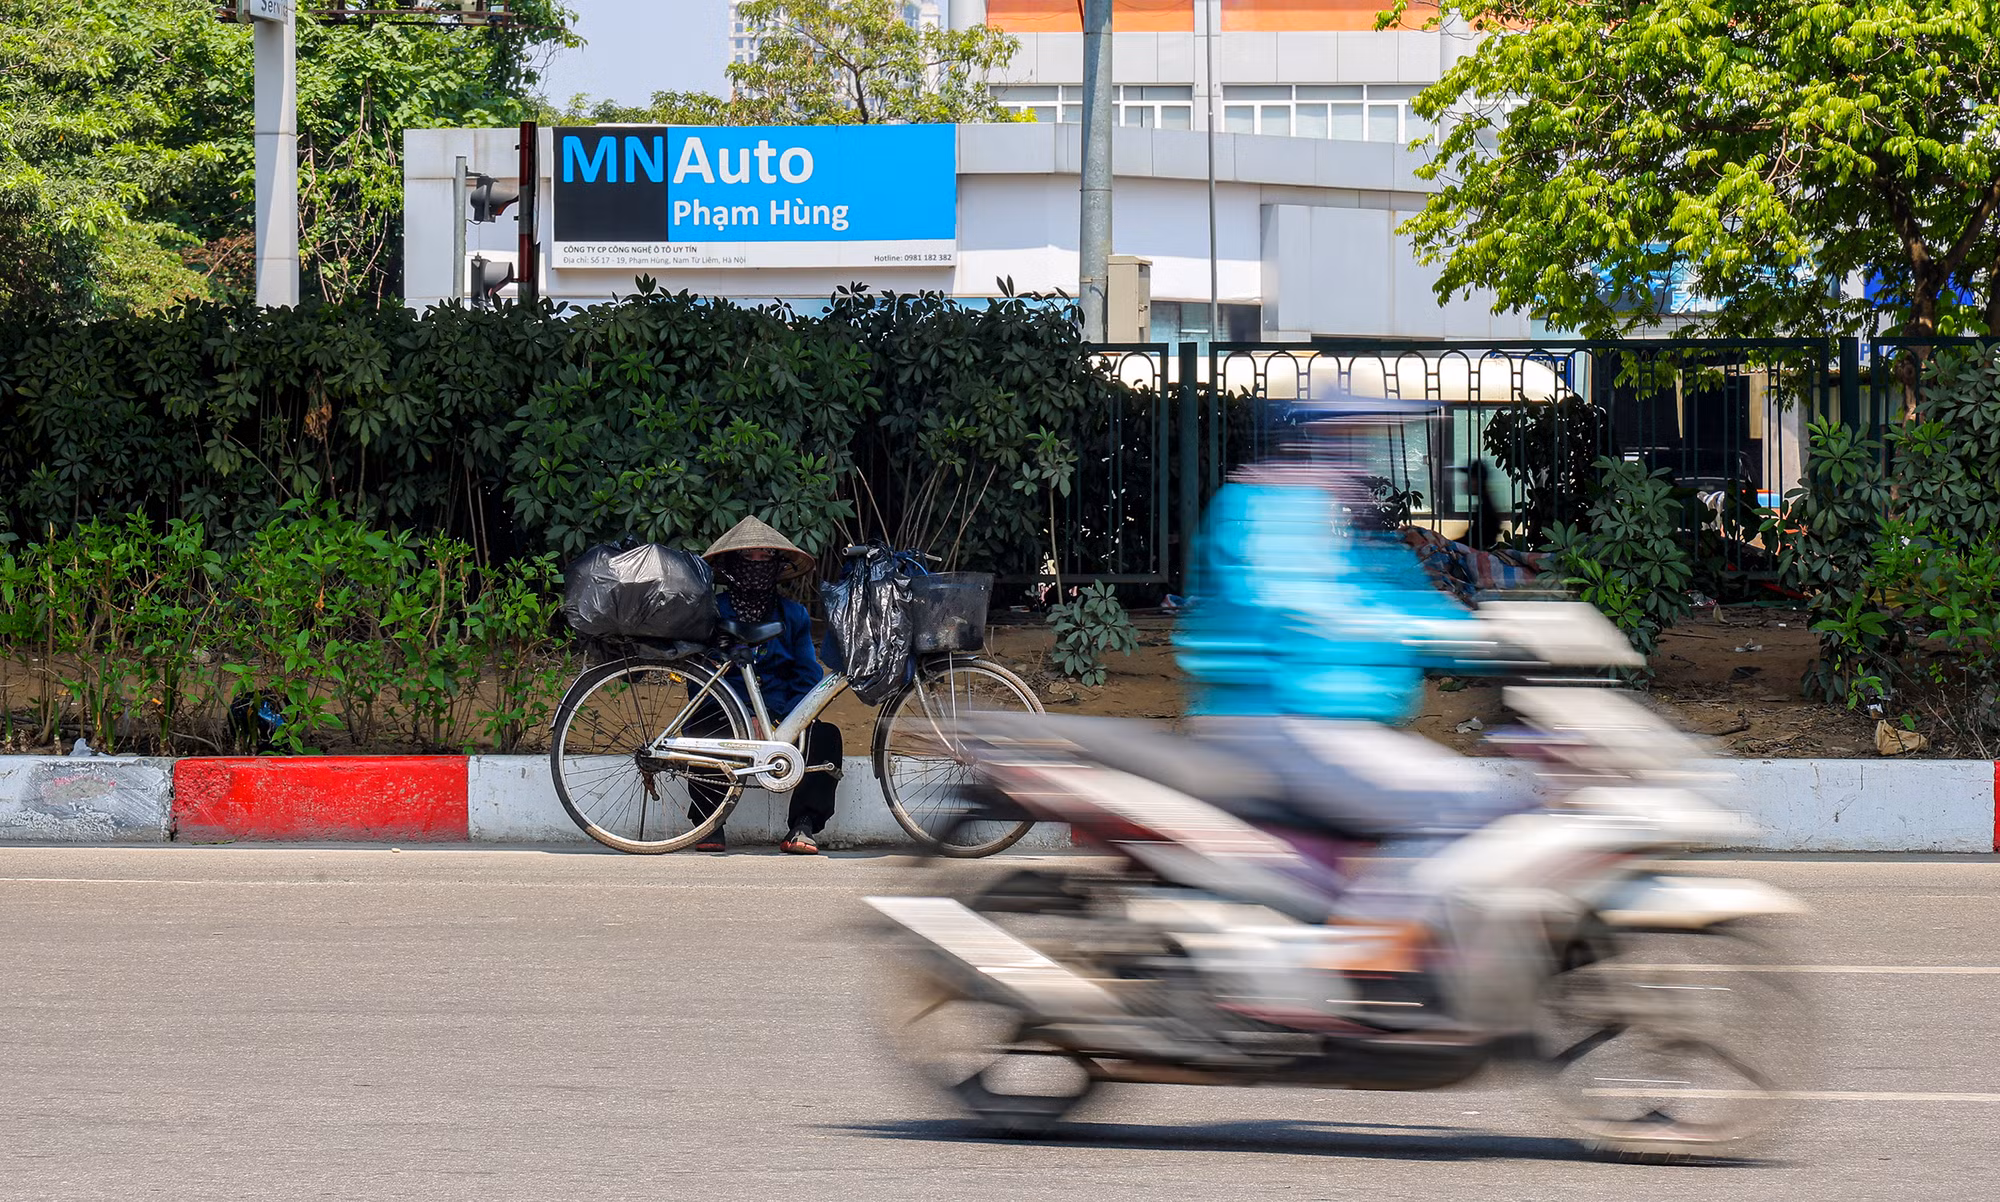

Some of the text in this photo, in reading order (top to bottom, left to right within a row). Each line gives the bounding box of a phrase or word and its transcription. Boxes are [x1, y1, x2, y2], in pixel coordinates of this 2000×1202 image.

[673, 198, 849, 231] Phạm Hùng
[563, 245, 585, 253] CÔNG
[608, 245, 630, 253] CÔNG
[631, 245, 652, 254] NGHỆ
[653, 245, 660, 253] Ô
[661, 245, 672, 253] TÔ
[685, 244, 697, 253] TÍN
[629, 256, 649, 264] Phạm
[722, 256, 732, 264] Hà
[733, 256, 746, 264] Nội
[874, 254, 903, 262] Hotline:
